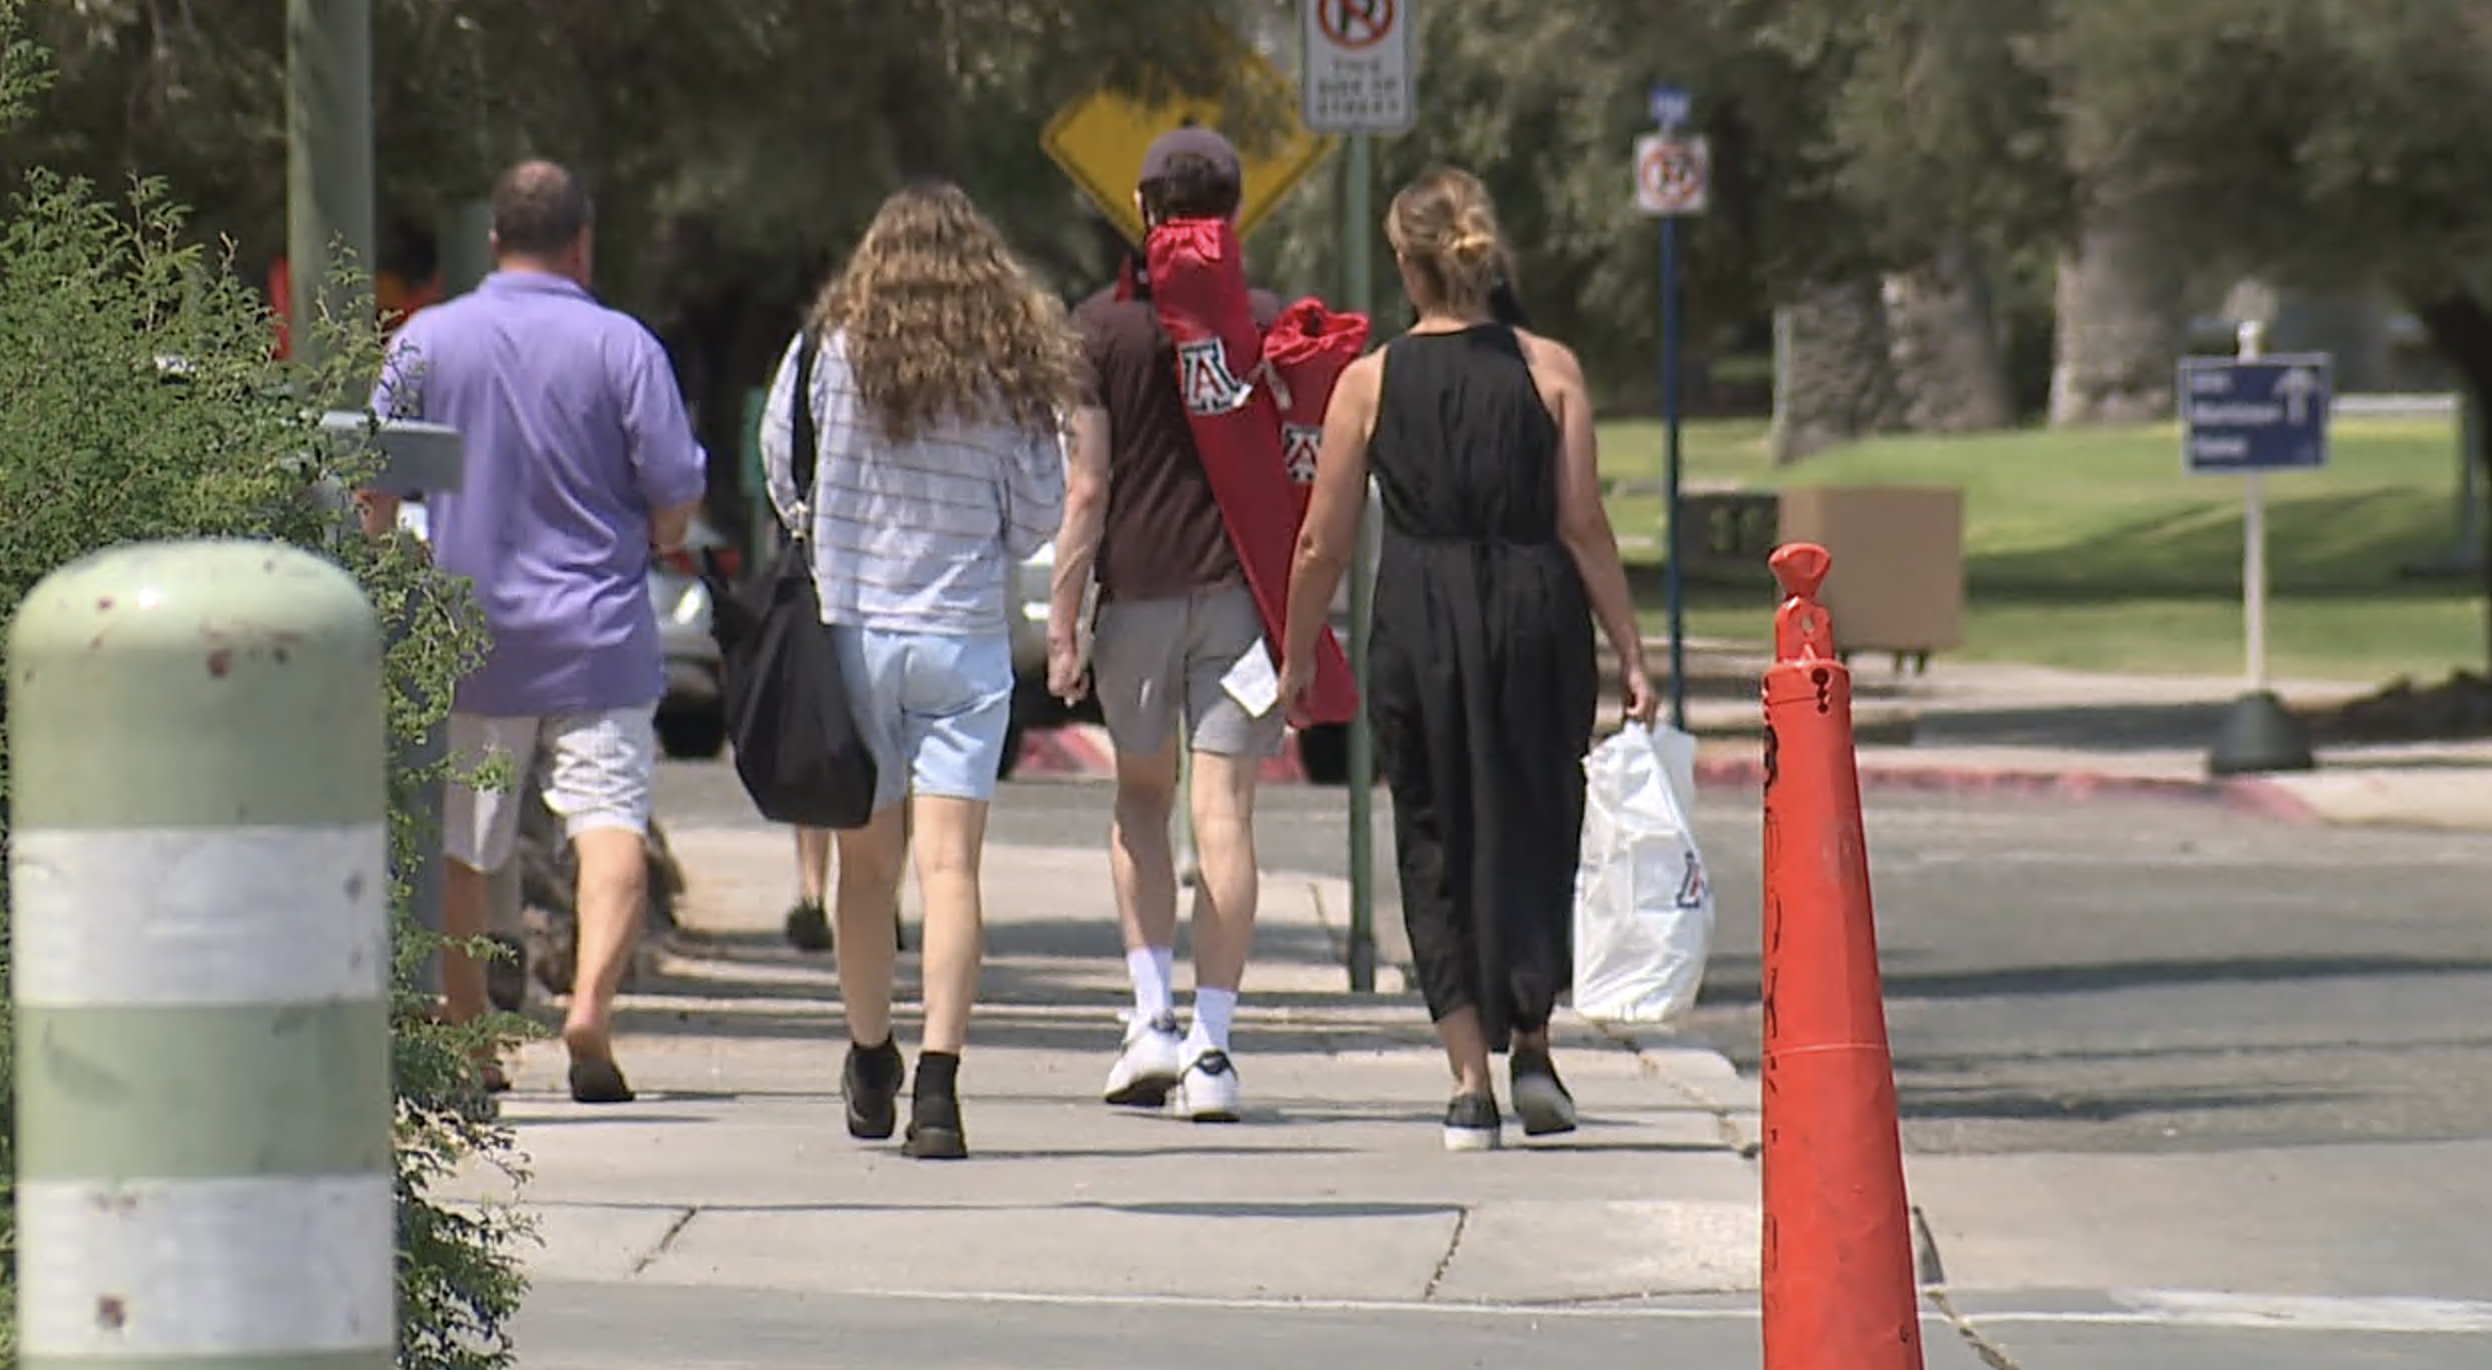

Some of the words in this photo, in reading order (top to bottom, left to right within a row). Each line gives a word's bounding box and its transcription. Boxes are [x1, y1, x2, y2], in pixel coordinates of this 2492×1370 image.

[1317, 98, 1400, 116] STREET
[1179, 337, 1249, 415] A
[1282, 421, 1323, 485] A
